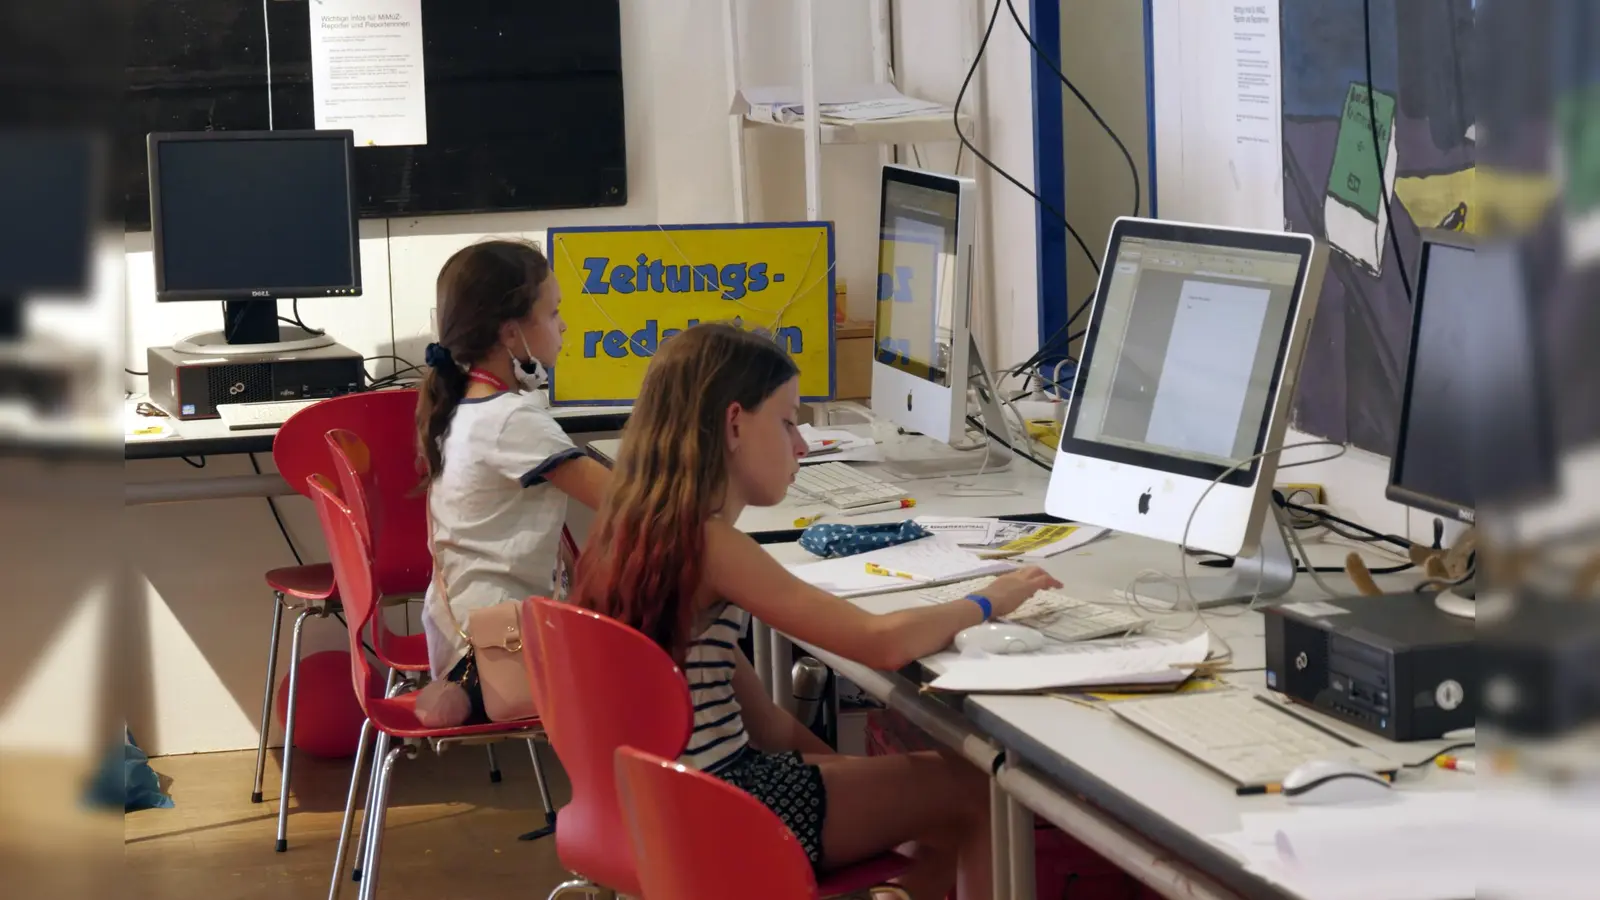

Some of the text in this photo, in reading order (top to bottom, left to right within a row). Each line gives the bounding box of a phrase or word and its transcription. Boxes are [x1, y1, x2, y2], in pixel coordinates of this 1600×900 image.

[321, 22, 349, 30] Reporter
[365, 21, 411, 29] Reporterinnen
[581, 253, 785, 300] Zeitungs-
